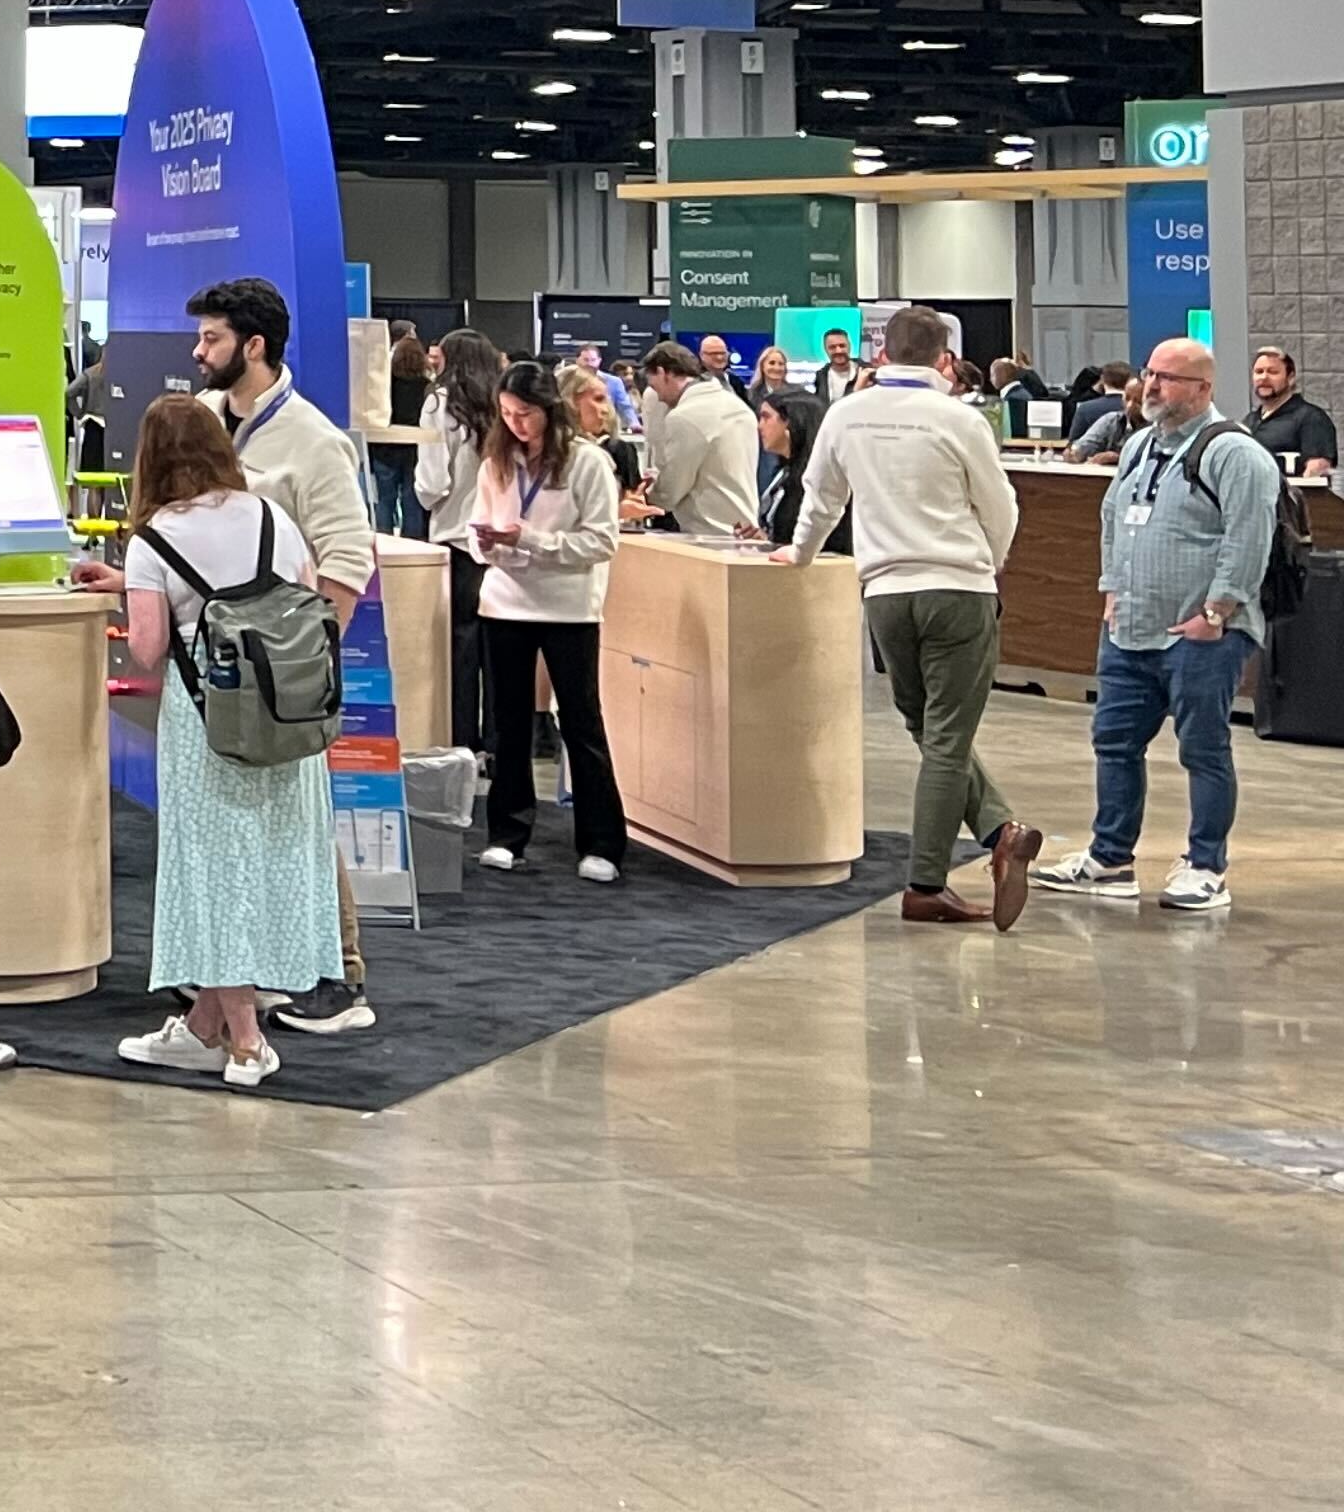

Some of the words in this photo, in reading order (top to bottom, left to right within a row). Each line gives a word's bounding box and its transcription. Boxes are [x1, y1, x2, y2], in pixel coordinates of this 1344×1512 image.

[149, 119, 169, 153] Your
[170, 110, 195, 150] 2025
[196, 105, 234, 146] Privacy
[161, 162, 191, 198] Vision
[192, 153, 221, 194] Board
[1156, 219, 1204, 240] Use
[681, 269, 749, 285] Consent
[681, 292, 788, 311] Management
